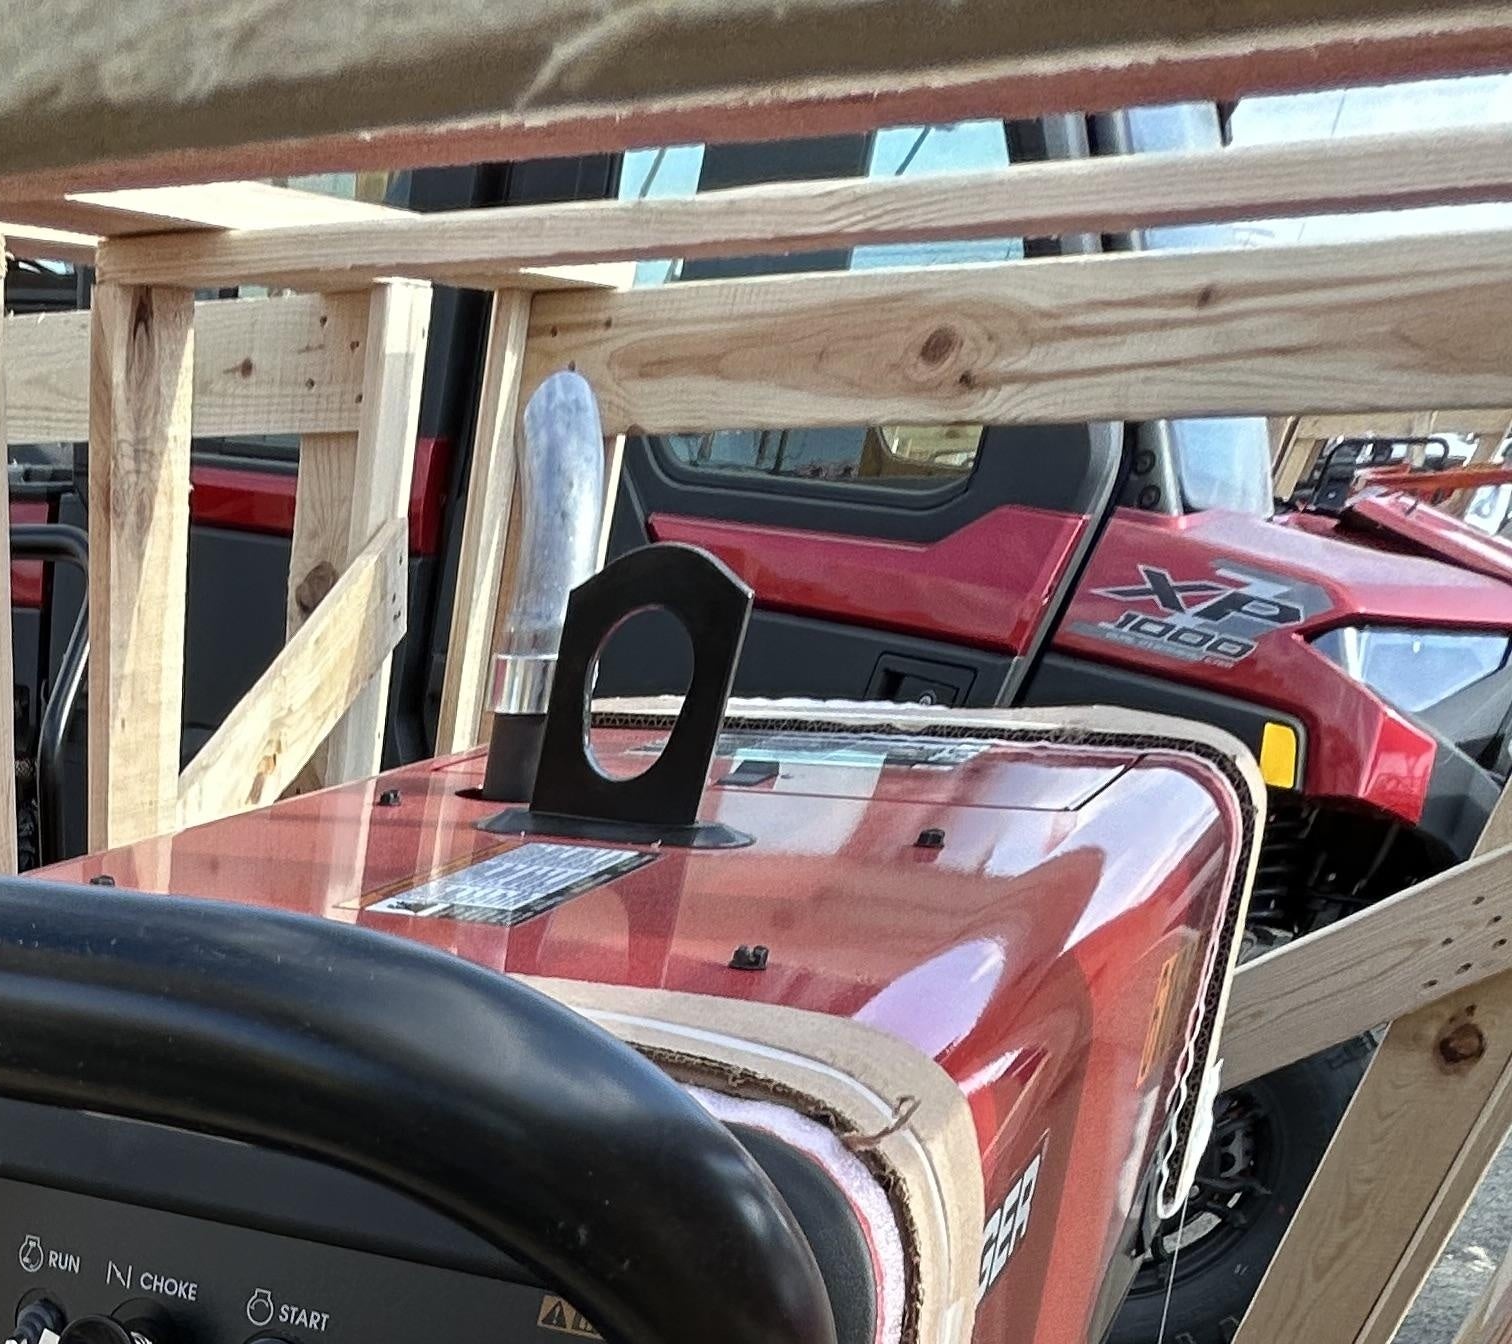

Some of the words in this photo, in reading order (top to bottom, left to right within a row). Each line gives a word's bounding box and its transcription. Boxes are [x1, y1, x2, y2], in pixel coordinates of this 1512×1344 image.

[1089, 564, 1305, 627] XP
[1116, 610, 1258, 661] 1000
[48, 1250, 80, 1274] RUN
[140, 1272, 197, 1301] CHOKE
[278, 1304, 330, 1331] START
